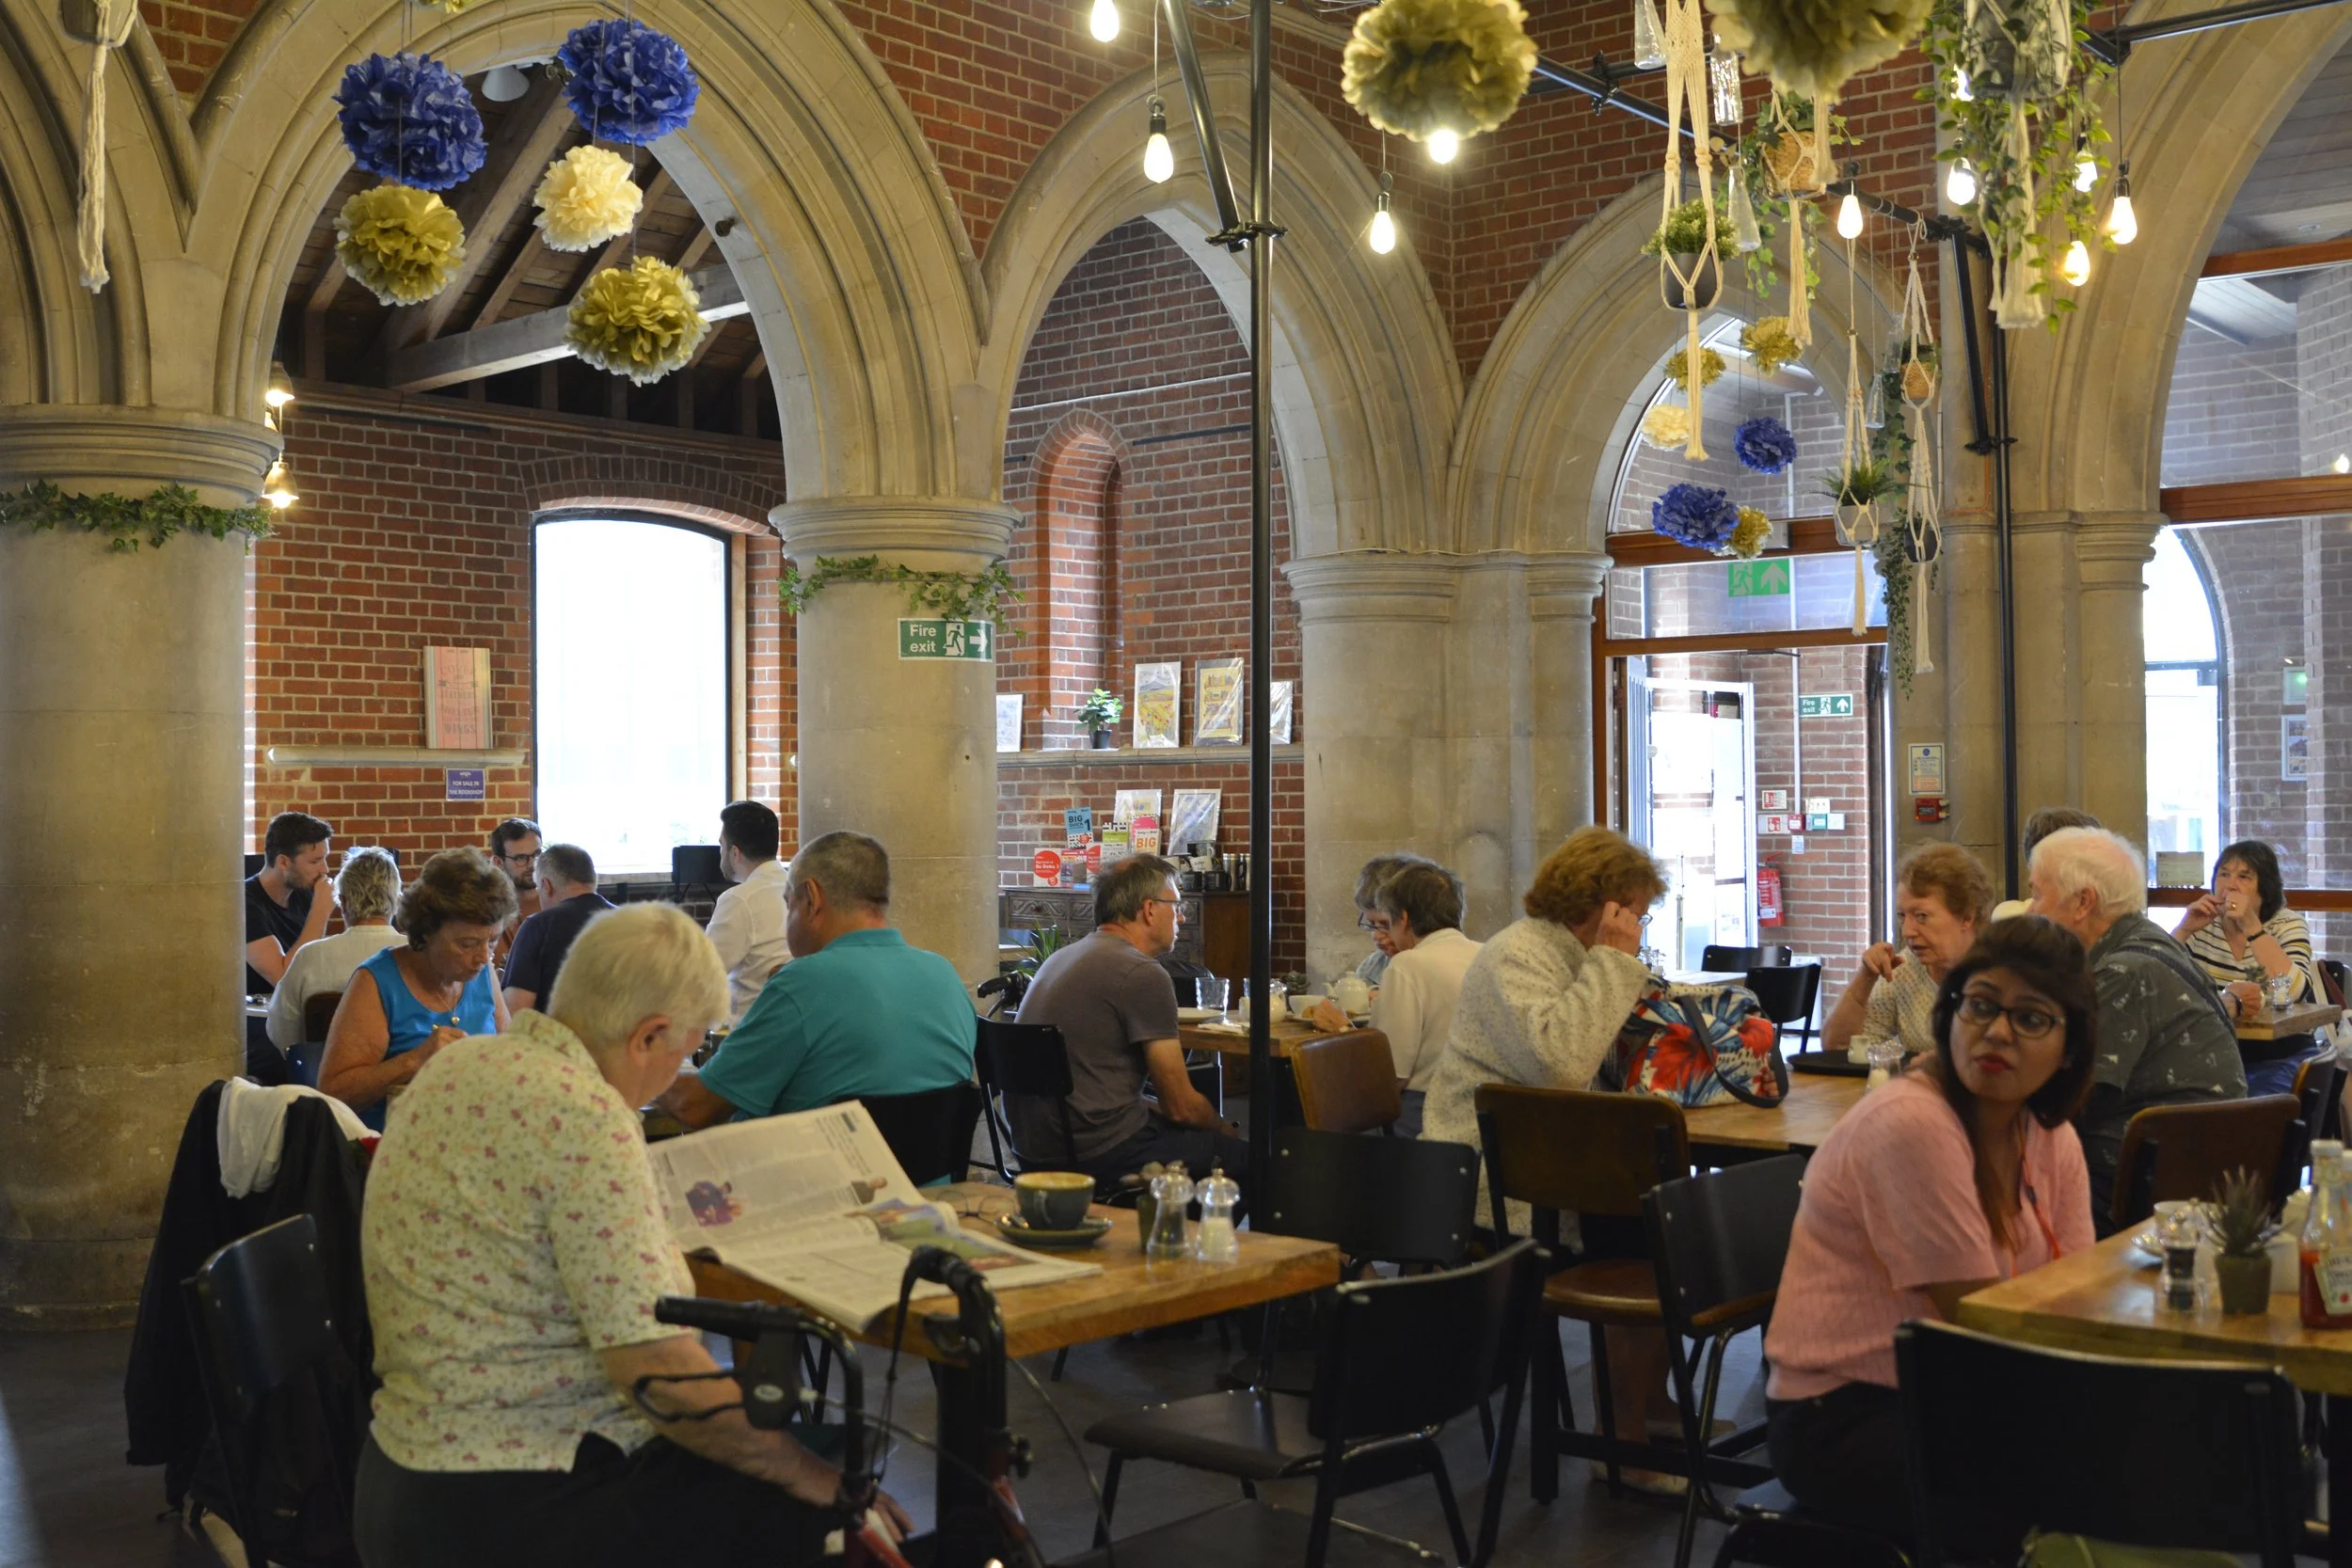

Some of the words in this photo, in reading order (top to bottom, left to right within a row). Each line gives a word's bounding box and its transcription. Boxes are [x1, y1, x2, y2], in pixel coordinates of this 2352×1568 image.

[910, 624, 937, 636] Fire
[910, 640, 937, 653] exit
[1068, 815, 1083, 823] BIG
[1084, 818, 1091, 831] 1
[1136, 837, 1157, 848] BIG
